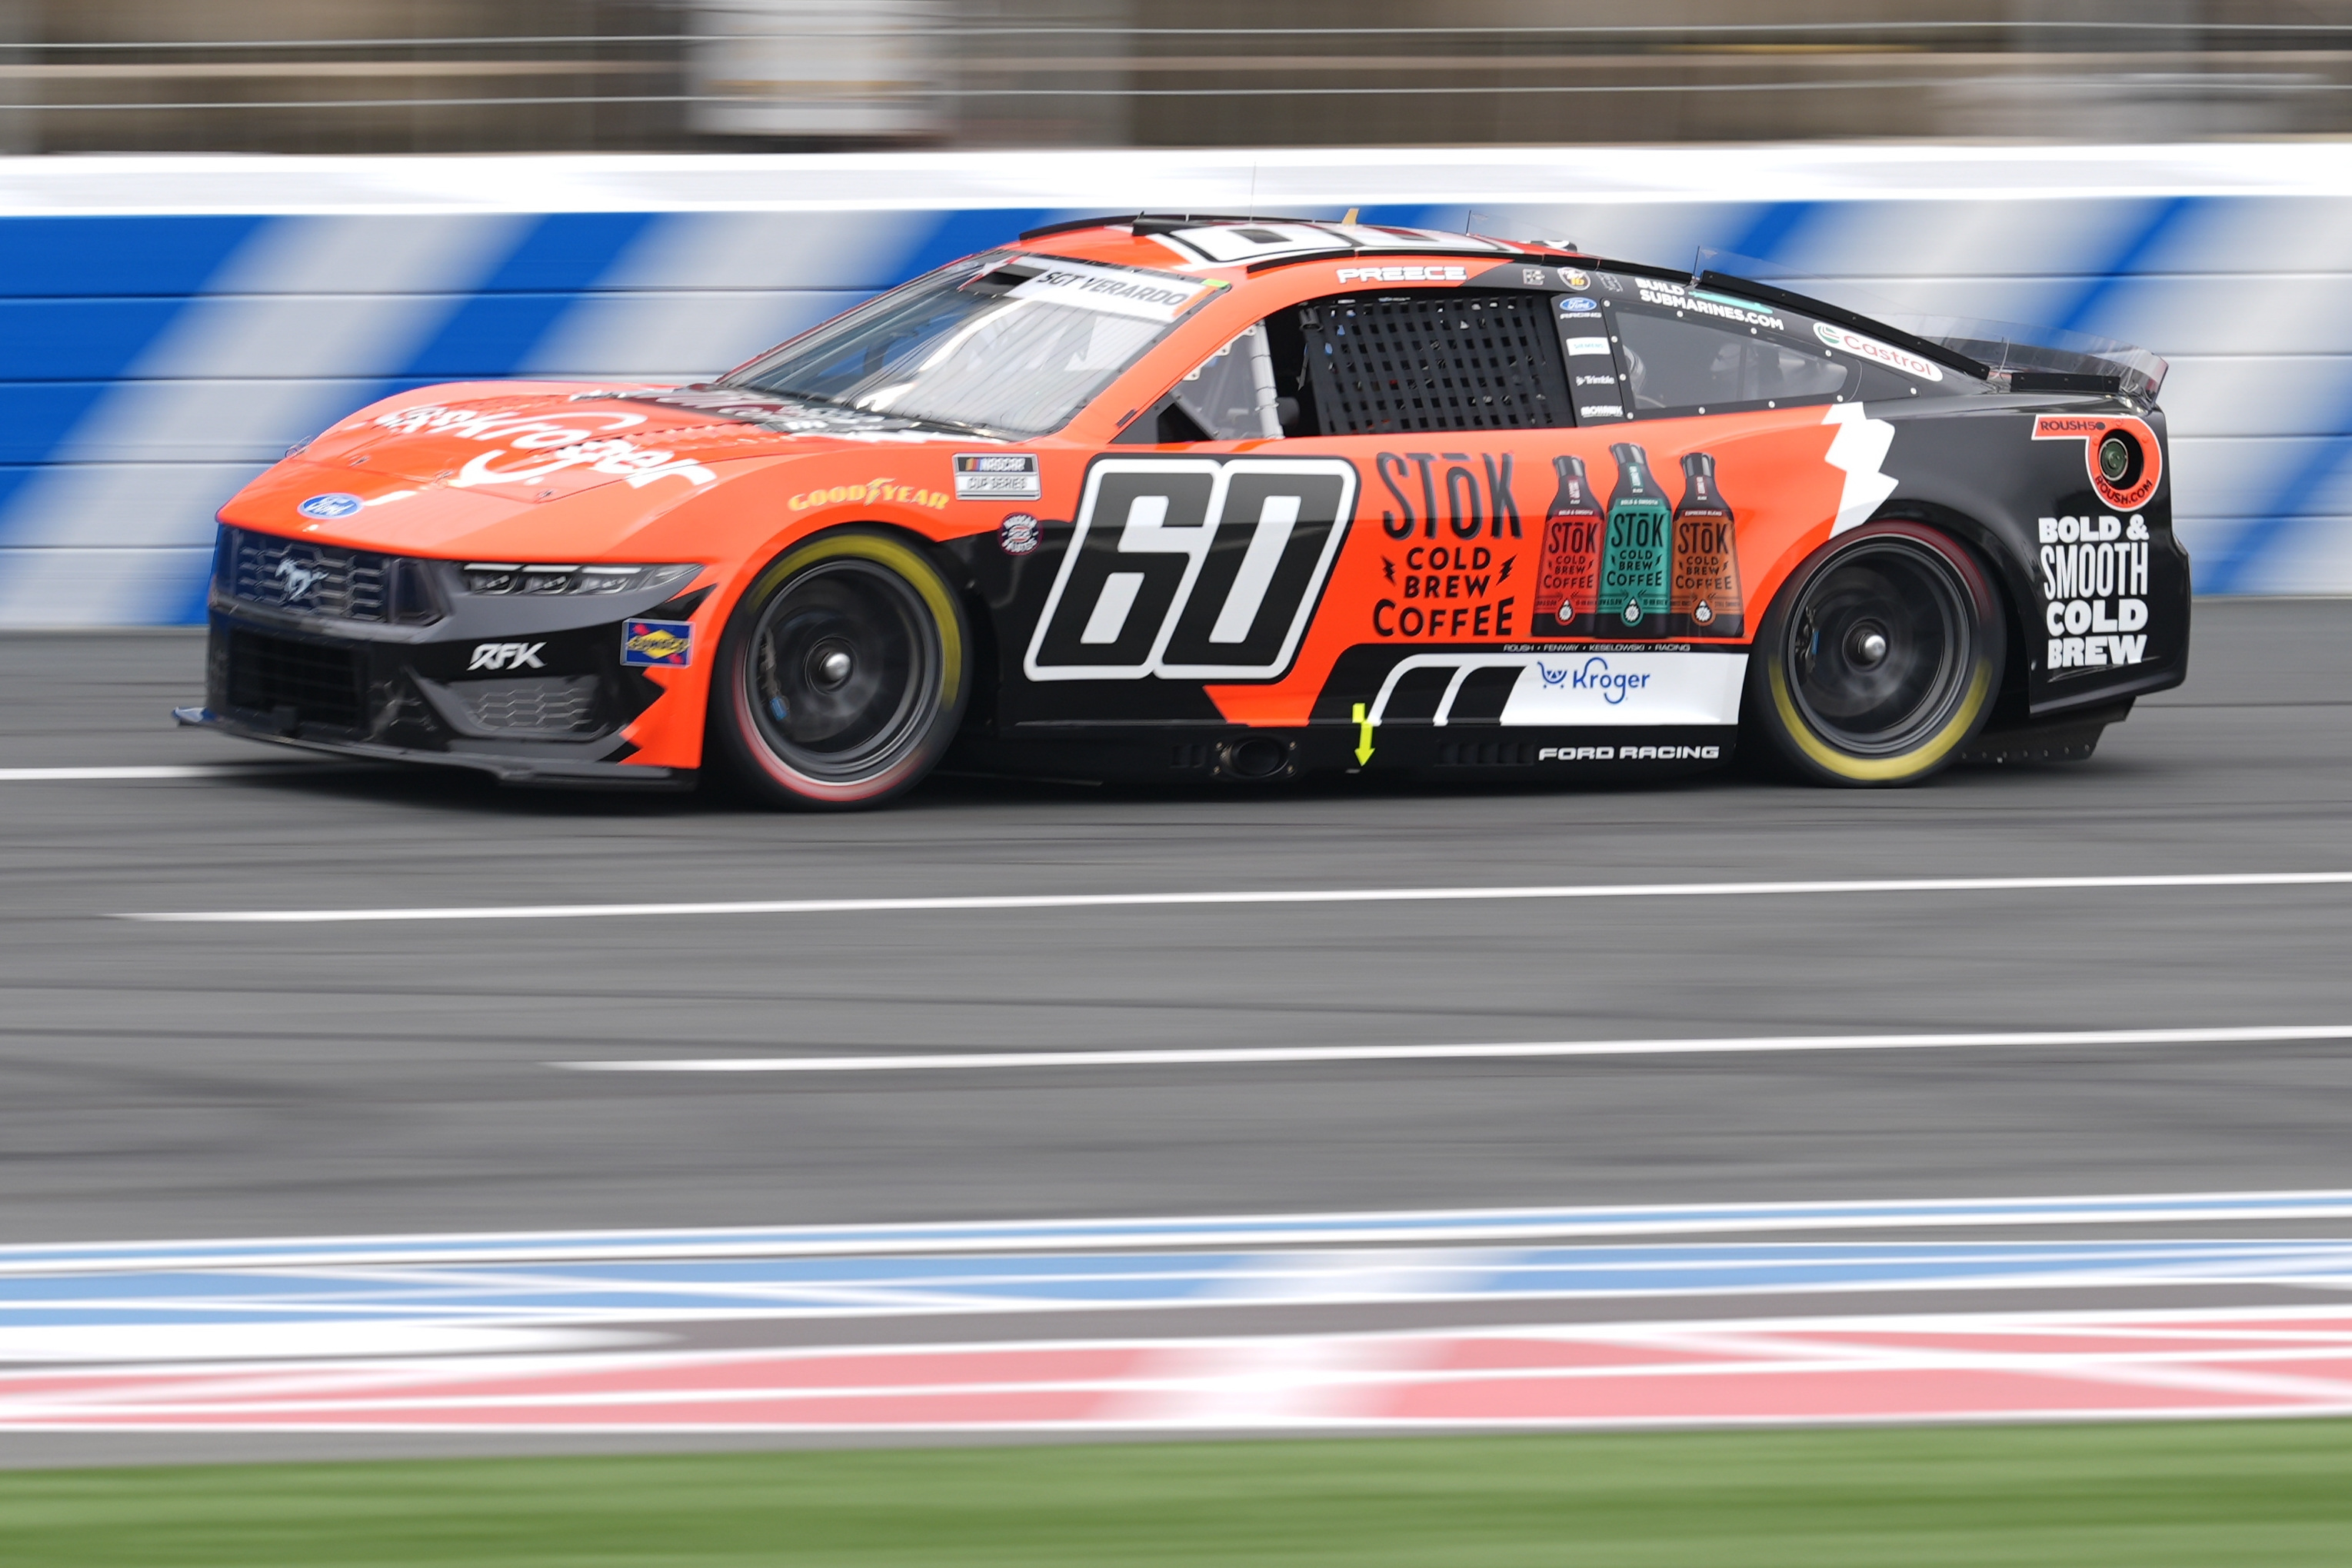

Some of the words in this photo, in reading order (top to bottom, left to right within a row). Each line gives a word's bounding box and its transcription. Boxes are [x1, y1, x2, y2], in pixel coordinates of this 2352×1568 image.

[1337, 266, 1468, 283] PREECE
[1634, 277, 1685, 296] BUILD
[1038, 271, 1085, 287] SGT
[1078, 277, 1190, 306] VERARDO
[1640, 288, 1784, 331] SUBMARINES.COM
[1844, 335, 1931, 376] Castrol
[1584, 375, 1615, 385] Trimble
[788, 477, 950, 511] GOODYEAR
[2095, 475, 2154, 505] ROUSH.COM
[2038, 515, 2121, 544] BOLD
[2126, 514, 2150, 541] &
[1406, 546, 1491, 571] COLD
[1556, 555, 1586, 564] COLD
[1619, 561, 1653, 571] BREW
[1620, 550, 1653, 560] COLD
[1687, 556, 1719, 565] COLD
[1023, 457, 1360, 682] 60
[1544, 574, 1594, 589] COFFEE
[1554, 566, 1586, 574] BREW
[1607, 571, 1663, 587] COFFEE
[1686, 567, 1720, 576] BREW
[2040, 541, 2148, 601] SMOOTH
[1404, 574, 1491, 599] BREW
[1675, 575, 1732, 590] COFFEE
[1373, 595, 1515, 638] COFFEE
[2047, 598, 2148, 637] COLD
[466, 641, 548, 671] RFK
[1503, 644, 1534, 652] ROUSH
[1543, 644, 1579, 652] FENWAY
[1588, 644, 1645, 652] KESELOWSKI
[1654, 644, 1691, 652] RACING
[2047, 634, 2148, 669] BREW
[1573, 657, 1651, 704] Kroger
[1538, 747, 1614, 761] FORD
[1619, 745, 1720, 760] RACING
